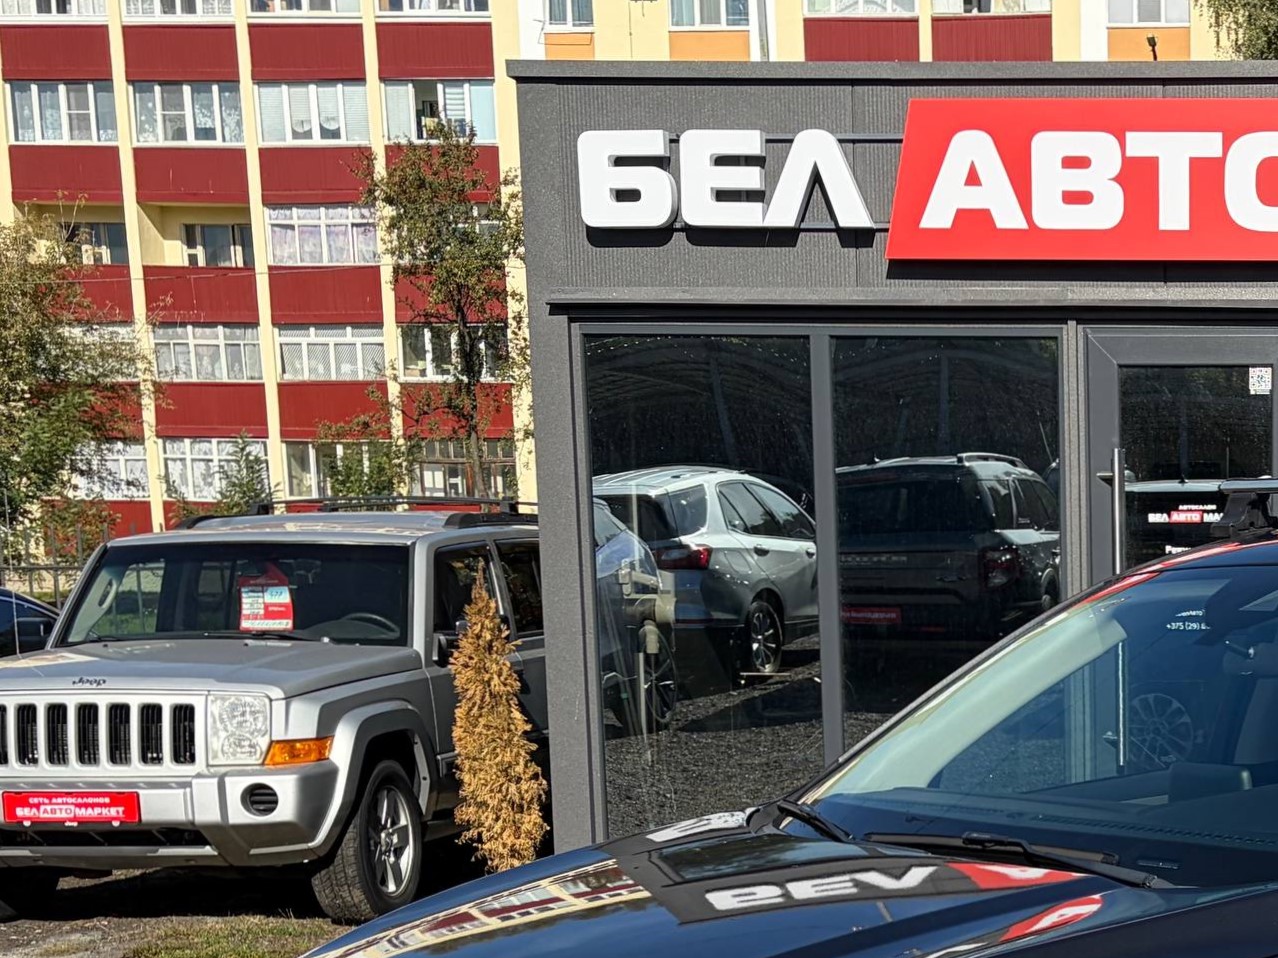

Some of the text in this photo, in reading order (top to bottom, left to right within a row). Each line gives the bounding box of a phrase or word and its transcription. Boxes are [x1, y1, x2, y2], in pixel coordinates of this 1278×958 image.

[577, 128, 876, 229] БЕЛ
[28, 796, 111, 804] СЕТЬ АВТОСАЛОНОВ
[41, 806, 74, 817] АВТО
[75, 806, 125, 817] МАРКЕТ
